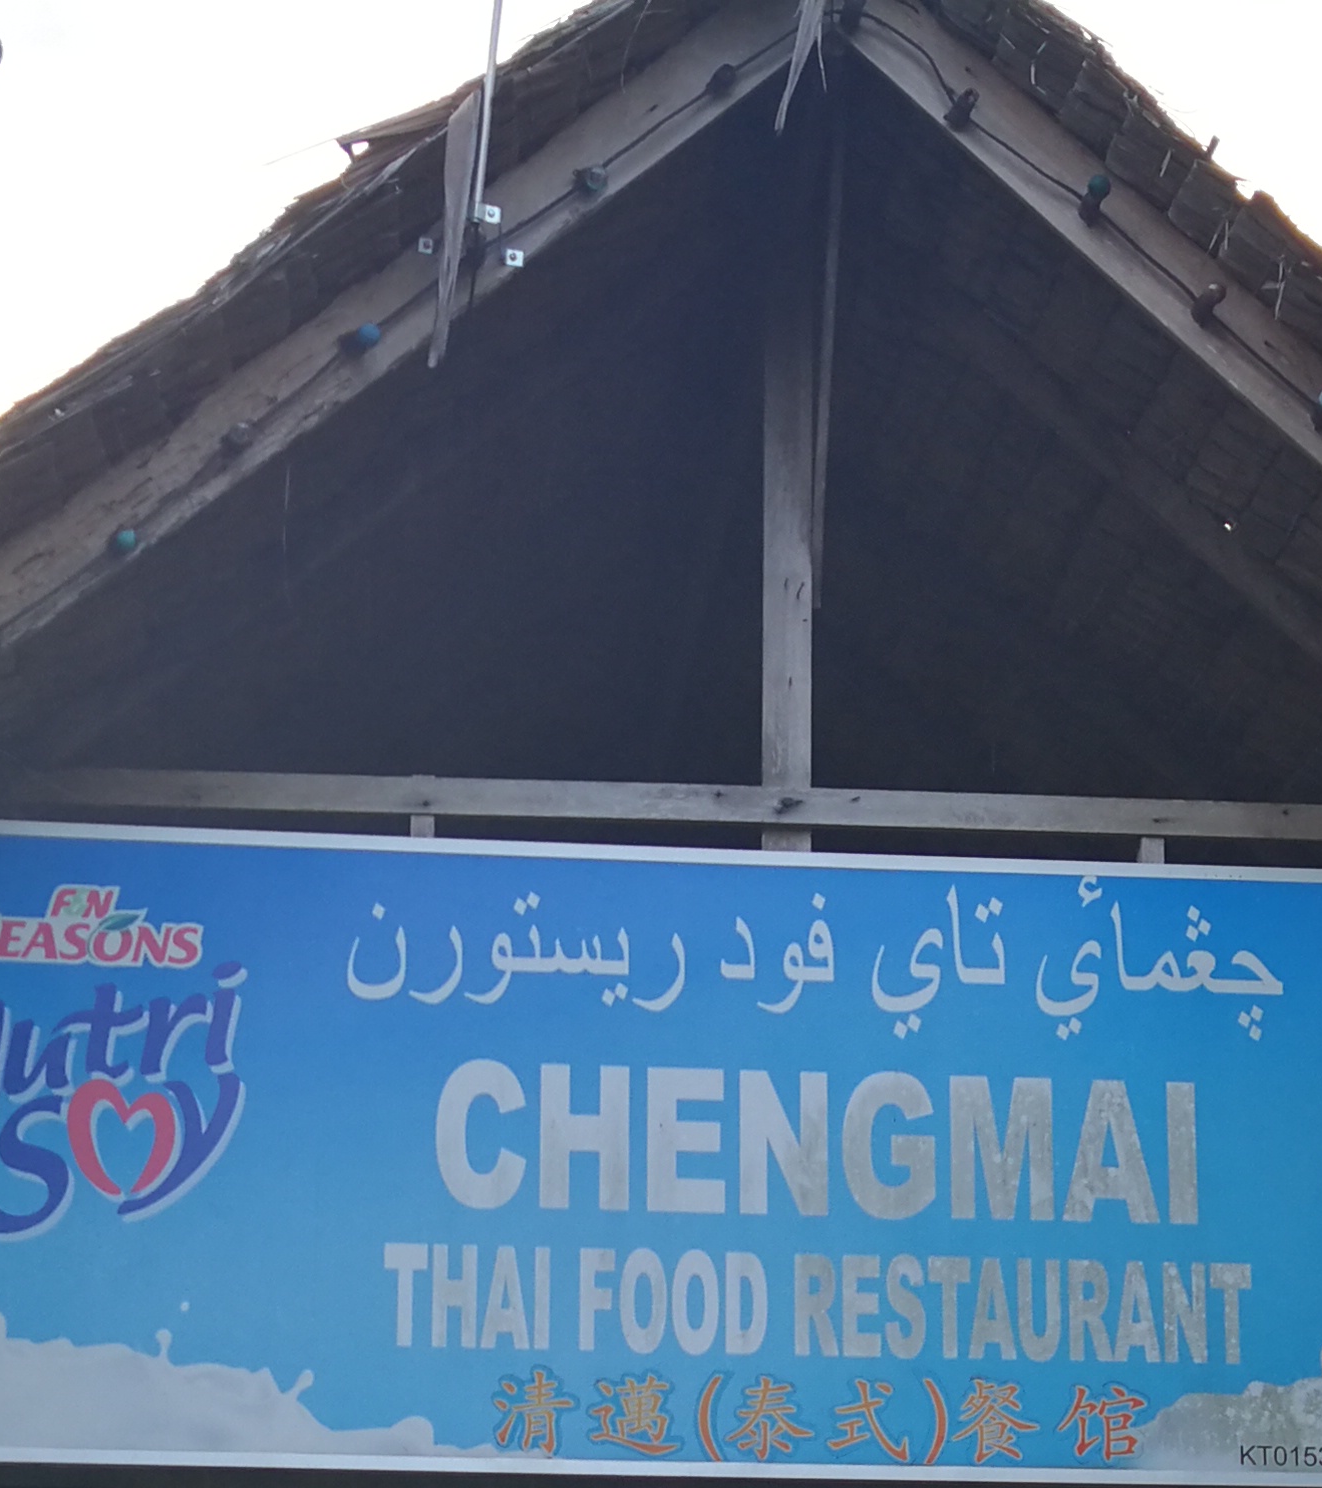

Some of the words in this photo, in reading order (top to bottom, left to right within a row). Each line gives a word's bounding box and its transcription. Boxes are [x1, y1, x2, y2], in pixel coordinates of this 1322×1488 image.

[435, 1058, 1199, 1225] CHENGMAI
[383, 1243, 551, 1351] THAI
[578, 1247, 768, 1356] FOOD
[793, 1253, 1252, 1365] RESTAURANT
